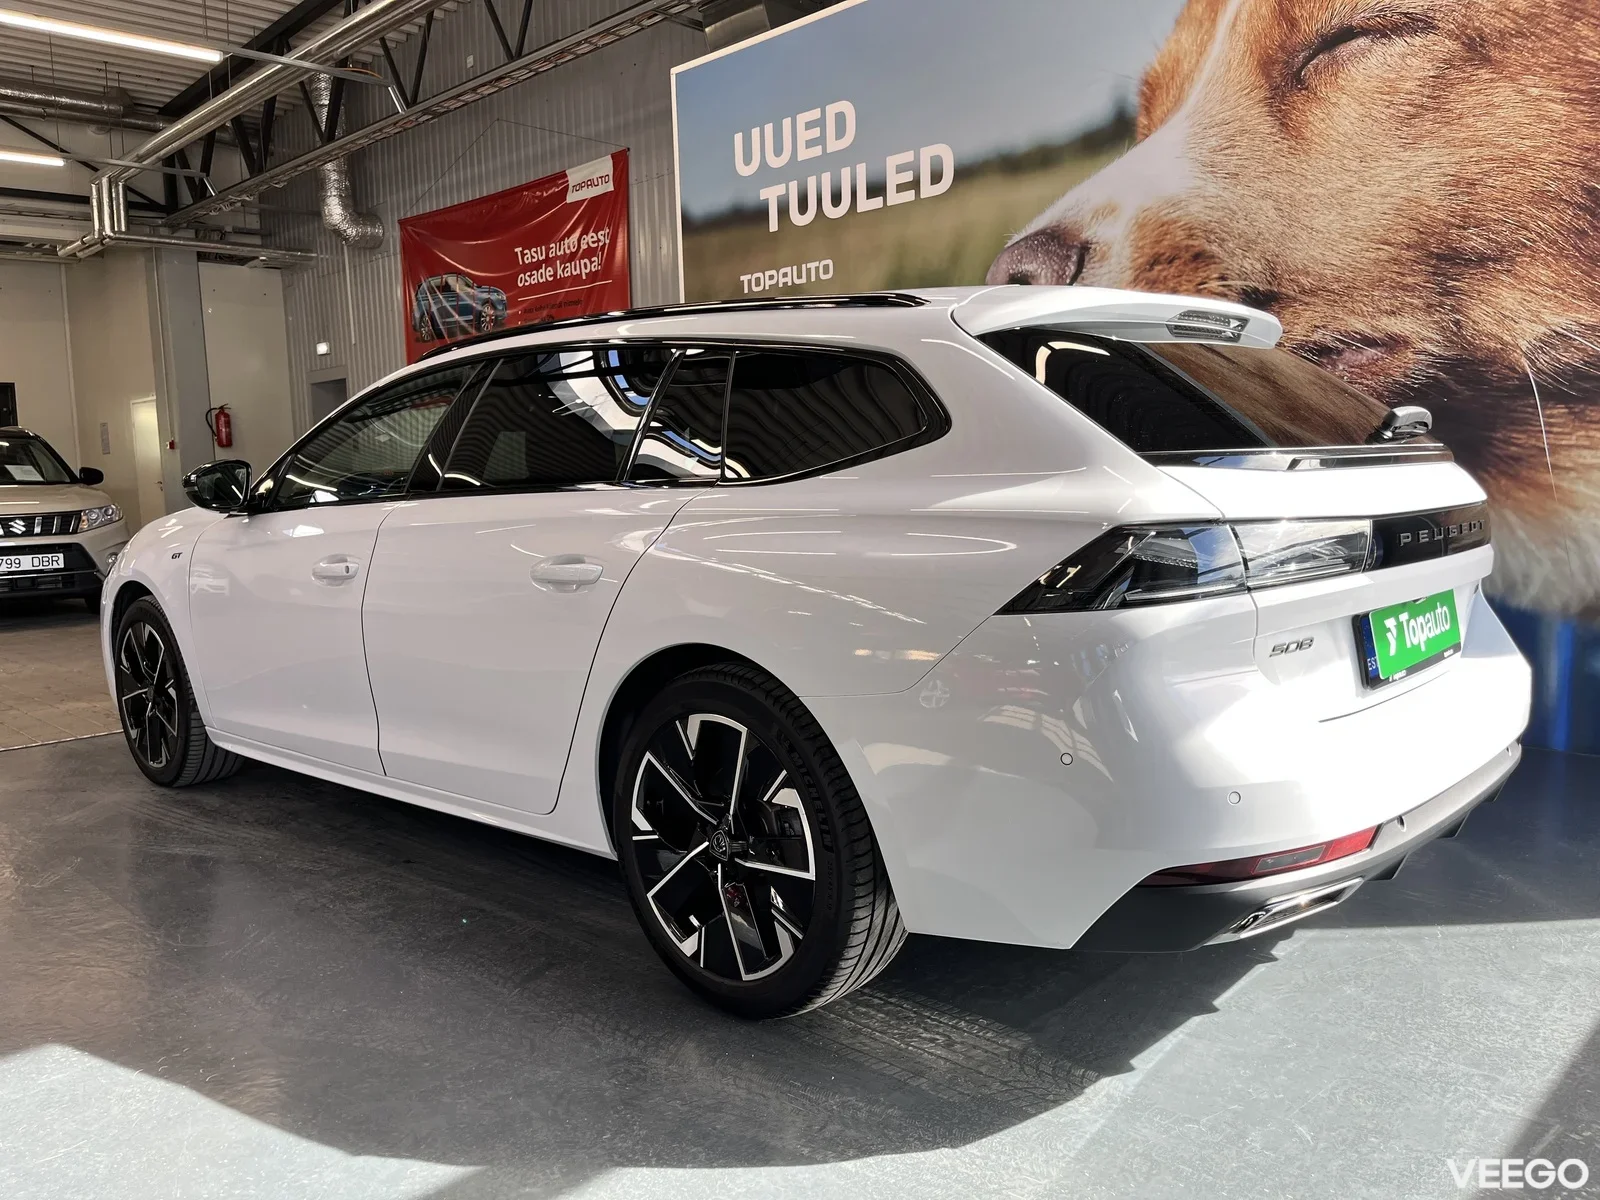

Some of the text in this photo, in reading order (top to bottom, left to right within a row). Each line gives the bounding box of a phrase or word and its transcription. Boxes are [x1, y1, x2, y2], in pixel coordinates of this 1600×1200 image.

[734, 100, 856, 177] UUED
[571, 173, 610, 194] TOPAUTO
[759, 143, 955, 233] TUULED
[514, 227, 610, 266] Tasu auto eest
[516, 254, 602, 288] osade kaupa!
[740, 259, 834, 294] TOPAUTO
[1399, 519, 1485, 547] PEUGEOT
[31, 555, 60, 568] DBR
[171, 552, 183, 560] GT
[1398, 603, 1451, 653] Topauto
[1269, 636, 1315, 658] 508
[789, 750, 833, 848] MICHELIN
